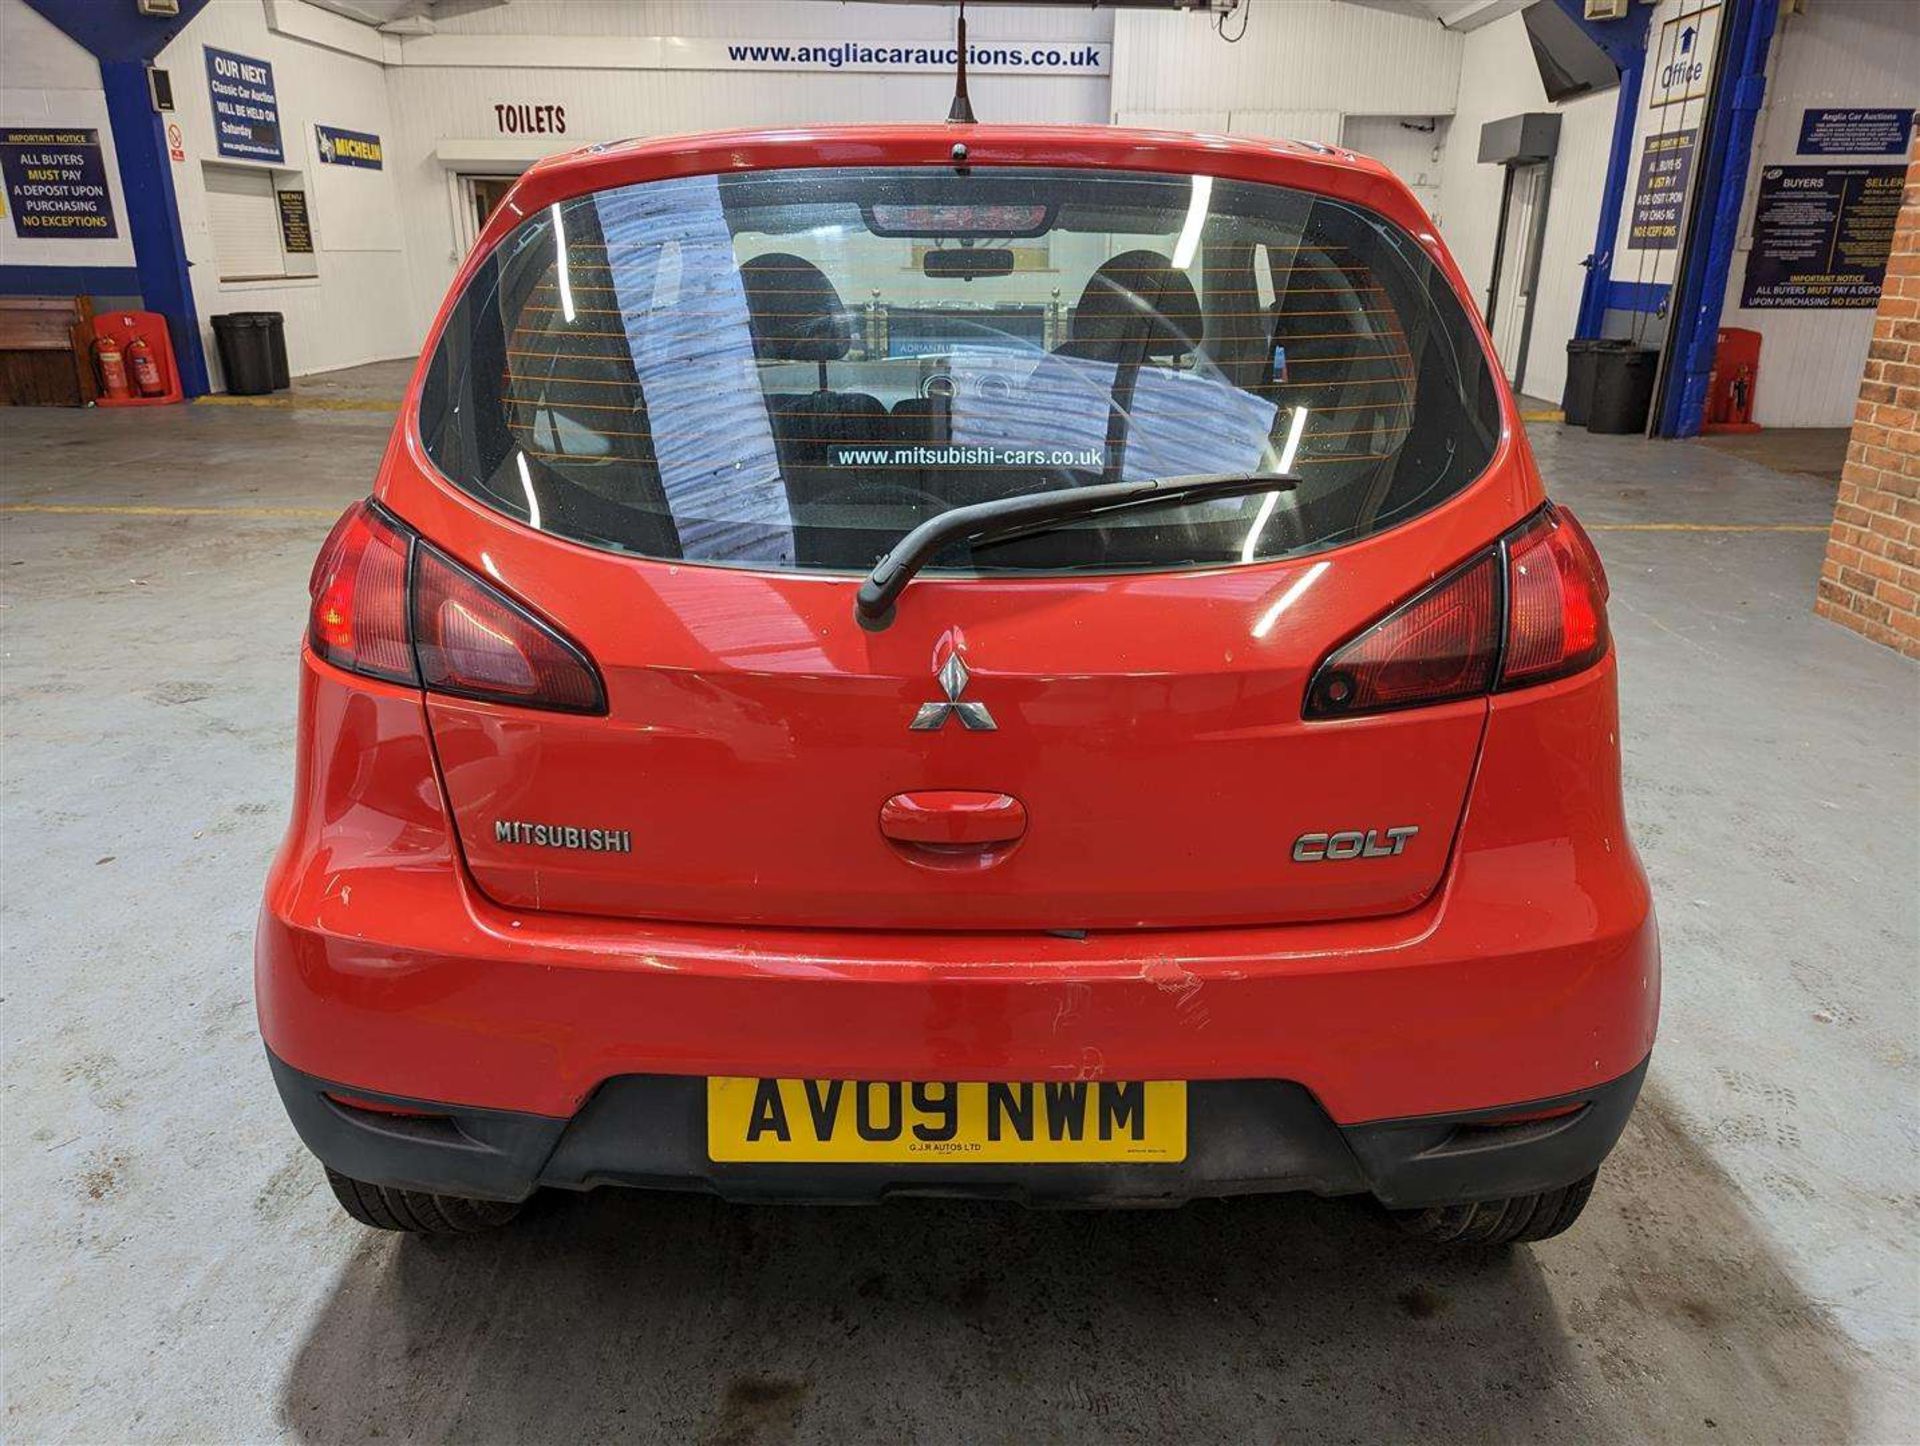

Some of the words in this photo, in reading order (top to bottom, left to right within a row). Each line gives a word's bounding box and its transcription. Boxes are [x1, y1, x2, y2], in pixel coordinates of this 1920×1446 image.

[215, 57, 239, 79] OUR
[241, 63, 267, 85] NEXT
[1661, 60, 1702, 89] Office
[212, 80, 237, 97] Classic
[238, 86, 251, 99] Car
[252, 89, 275, 103] Auction
[217, 101, 236, 115] WILL
[235, 104, 246, 117] BE
[246, 107, 265, 120] HELD
[265, 110, 277, 122] ON
[1822, 113, 1847, 122] Anglia
[1848, 112, 1861, 120] Car
[494, 104, 566, 134] TOILETS
[221, 121, 252, 139] Saturday
[9, 134, 54, 143] IMPORTANT
[56, 135, 86, 143] NOTICE
[335, 137, 382, 161] MICHELIN
[20, 154, 40, 165] ALL
[42, 155, 84, 166] BUYERS
[28, 169, 60, 180] MUST
[62, 170, 82, 180] PAY
[1783, 178, 1824, 188] BUYERS
[14, 185, 22, 196] A
[23, 185, 69, 196] DEPOSIT
[71, 186, 103, 196] UPON
[1642, 193, 1665, 205] DEOSIT
[26, 201, 97, 211] PURCHASING
[1639, 209, 1675, 221] PUCHASNG
[23, 216, 40, 226] NO
[42, 216, 108, 227] EXCEPTIONS
[1790, 274, 1834, 282] IMPORTANT
[1836, 274, 1864, 282] NOTICE
[1756, 286, 1771, 294] ALL
[1773, 286, 1806, 294] BUYERS
[1807, 286, 1832, 294] MUST
[1833, 286, 1849, 294] PAY
[1850, 286, 1857, 294] A
[1749, 297, 1773, 306] UPON
[1775, 297, 1830, 306] PURCHASING
[1831, 297, 1845, 306] NO
[838, 446, 1103, 466] www.mitsubishi-cars.co.uk
[495, 820, 631, 852] MITSUBISHI
[1292, 826, 1419, 862] COLT
[745, 1079, 958, 1142] AV09
[987, 1081, 1145, 1142] NWM
[934, 1142, 962, 1151] AUTOS
[964, 1143, 981, 1151] LTD
